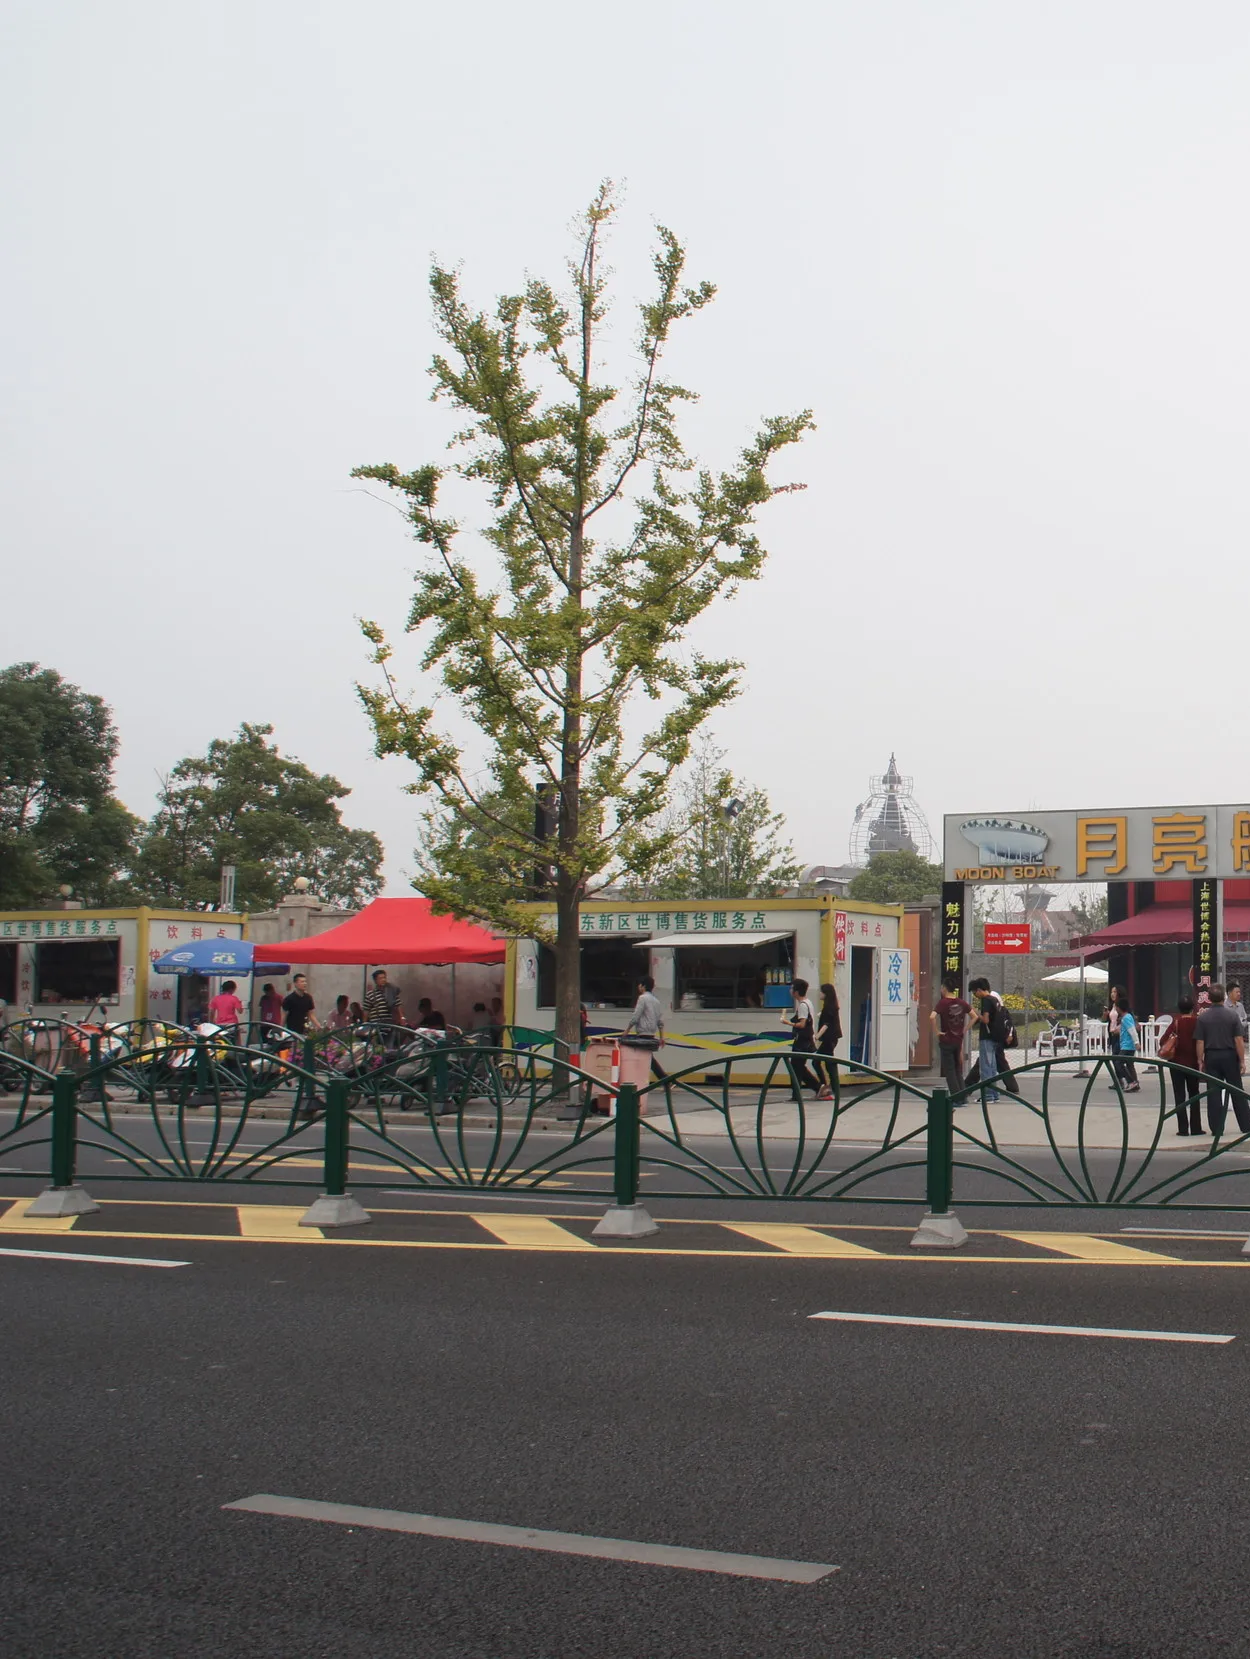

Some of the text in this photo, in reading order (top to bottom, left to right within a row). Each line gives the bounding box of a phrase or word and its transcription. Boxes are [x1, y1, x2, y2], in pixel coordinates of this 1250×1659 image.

[954, 866, 1060, 880] MOON BOAT
[581, 911, 767, 931] 东新区世博售货服务点
[847, 920, 881, 937] 饮料点
[945, 902, 960, 972] 魅力世博
[1200, 881, 1211, 972] 上海世博会热门场馆
[888, 952, 902, 1002] 冷饮
